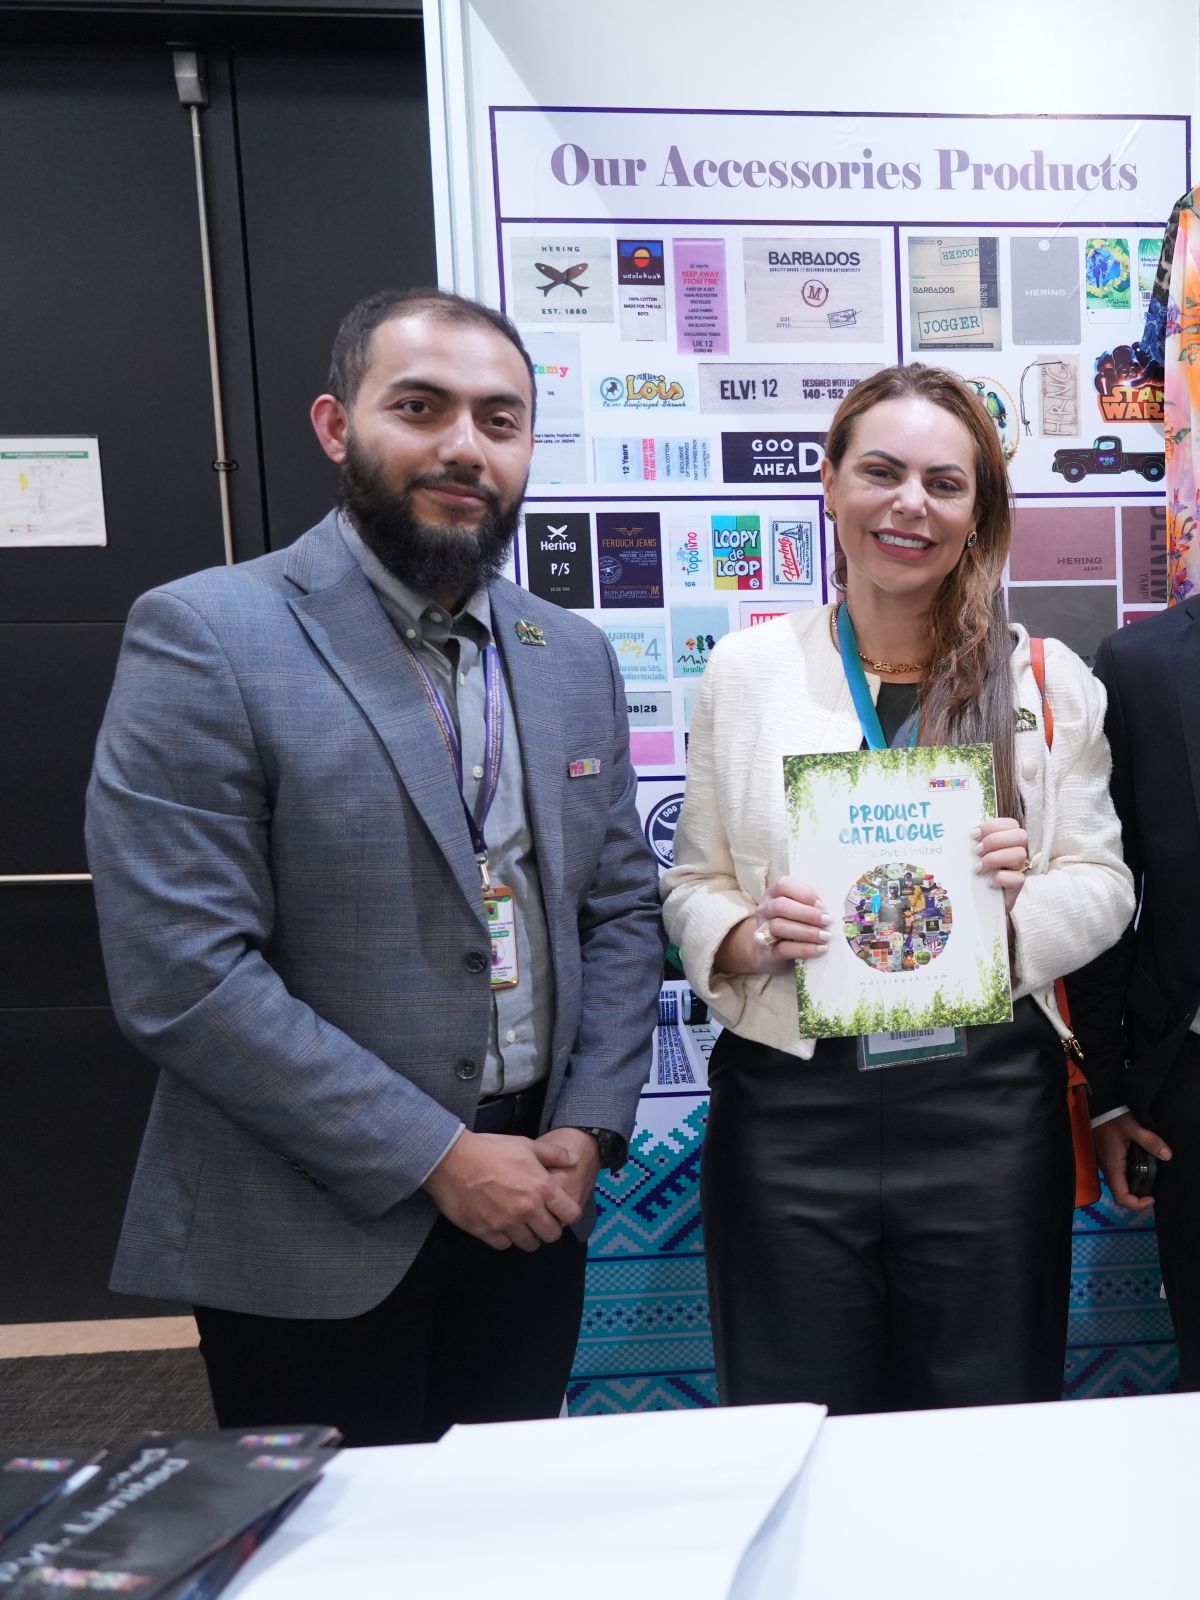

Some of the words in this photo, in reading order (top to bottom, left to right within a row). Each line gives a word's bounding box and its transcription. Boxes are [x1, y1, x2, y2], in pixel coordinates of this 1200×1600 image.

[551, 143, 646, 187] Our
[656, 145, 922, 190] Accessories
[934, 148, 1138, 192] Products
[768, 251, 861, 266] BARBADOS
[942, 248, 980, 260] JOGGER
[807, 285, 823, 301] M
[1025, 289, 1067, 297] HERING
[923, 316, 980, 334] JOGGER
[626, 374, 685, 401] Lois
[720, 379, 757, 400] ELV!
[762, 379, 778, 398] 12
[802, 379, 832, 388] DESIGNED
[803, 389, 820, 399] 140
[827, 389, 844, 399] 152
[1102, 402, 1165, 420] WAR
[623, 465, 630, 475] 12
[540, 540, 577, 552] Hering
[635, 538, 657, 548] JEANS
[713, 529, 760, 548] LOOPY
[686, 531, 702, 576] Topolino
[729, 548, 745, 561] de
[778, 536, 796, 582] Hering
[1057, 557, 1102, 565] HERING
[550, 562, 570, 576] P/S
[717, 560, 760, 578] LOOP
[644, 638, 661, 661] 4
[849, 801, 931, 824] PRODUCT
[838, 823, 945, 845] CATALOGUE
